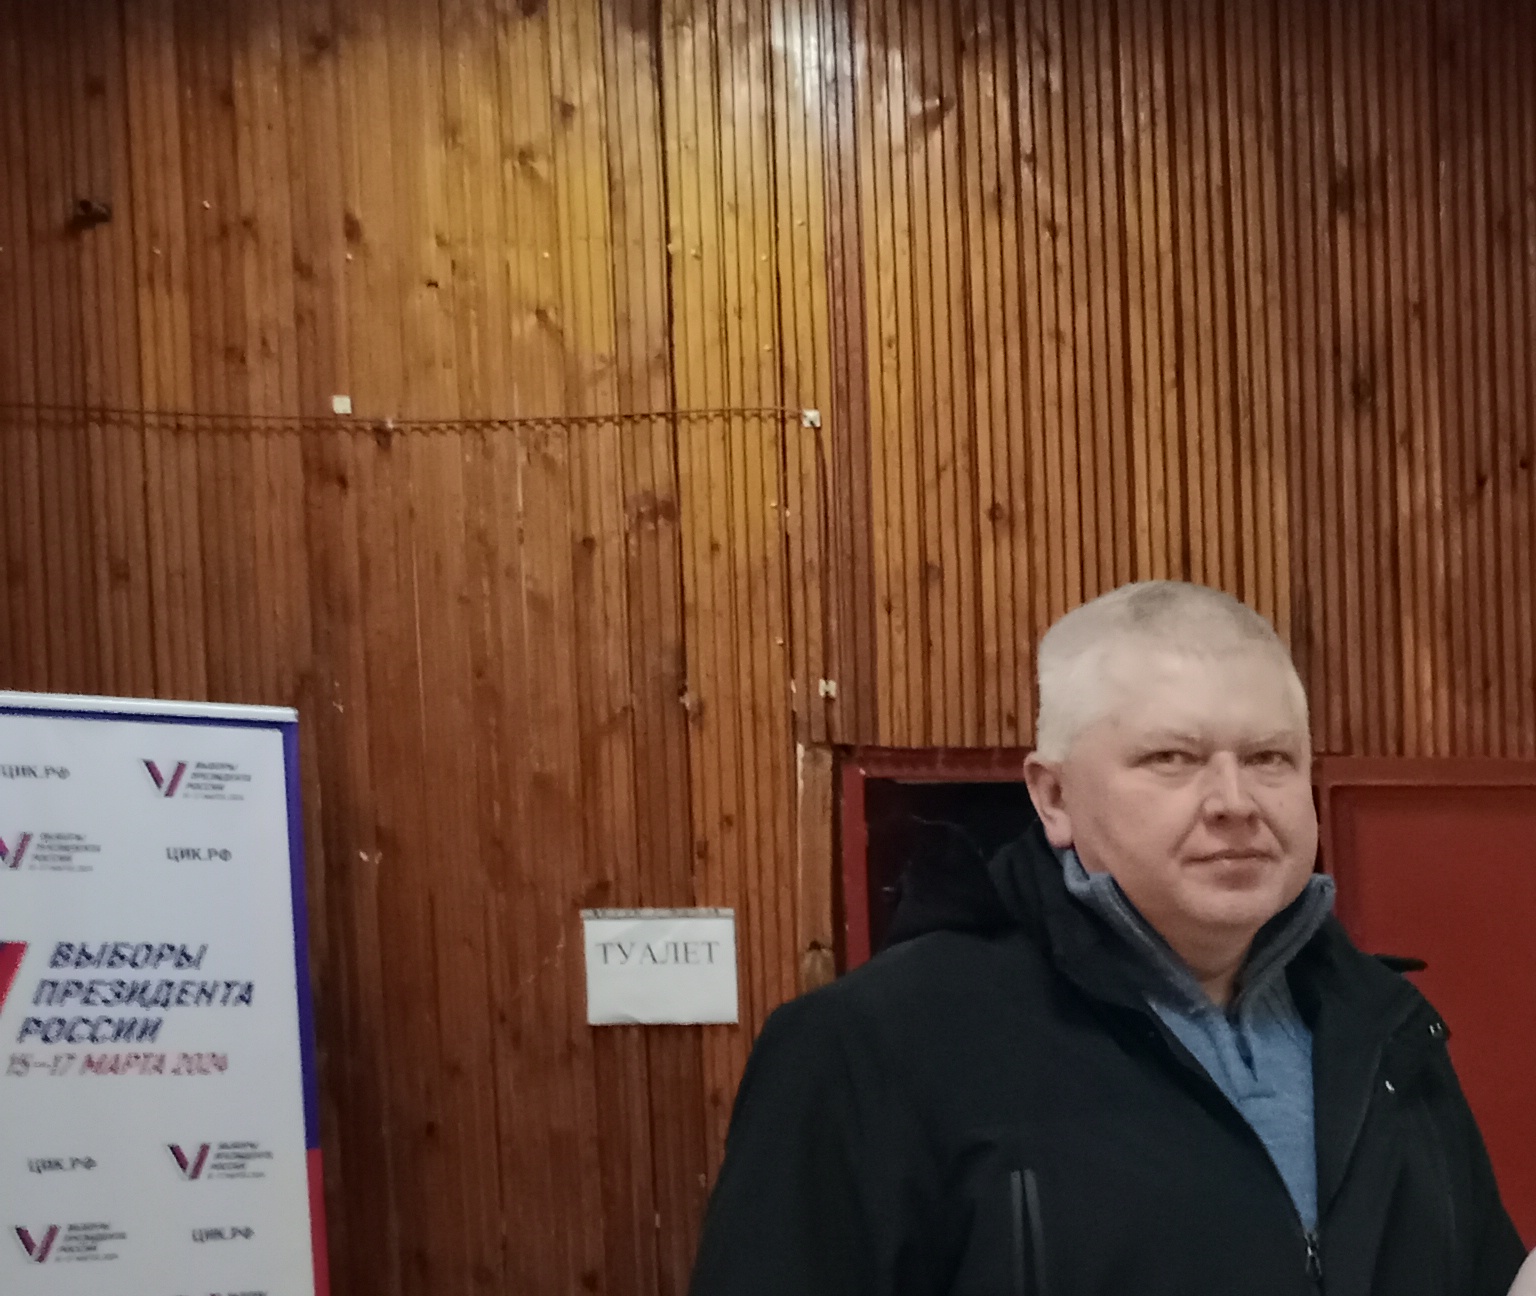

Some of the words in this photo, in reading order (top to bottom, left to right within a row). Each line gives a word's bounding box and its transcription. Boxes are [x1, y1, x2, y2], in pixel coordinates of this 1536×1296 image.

[49, 941, 208, 970] ВЫБОРЫ
[594, 941, 720, 966] ТУАЛЕТ
[33, 979, 256, 1010] ПРЕЗИДЕНТА
[16, 1016, 163, 1045] РОССИИ
[79, 1052, 166, 1077] МАРТА
[170, 1051, 229, 1077] 2024
